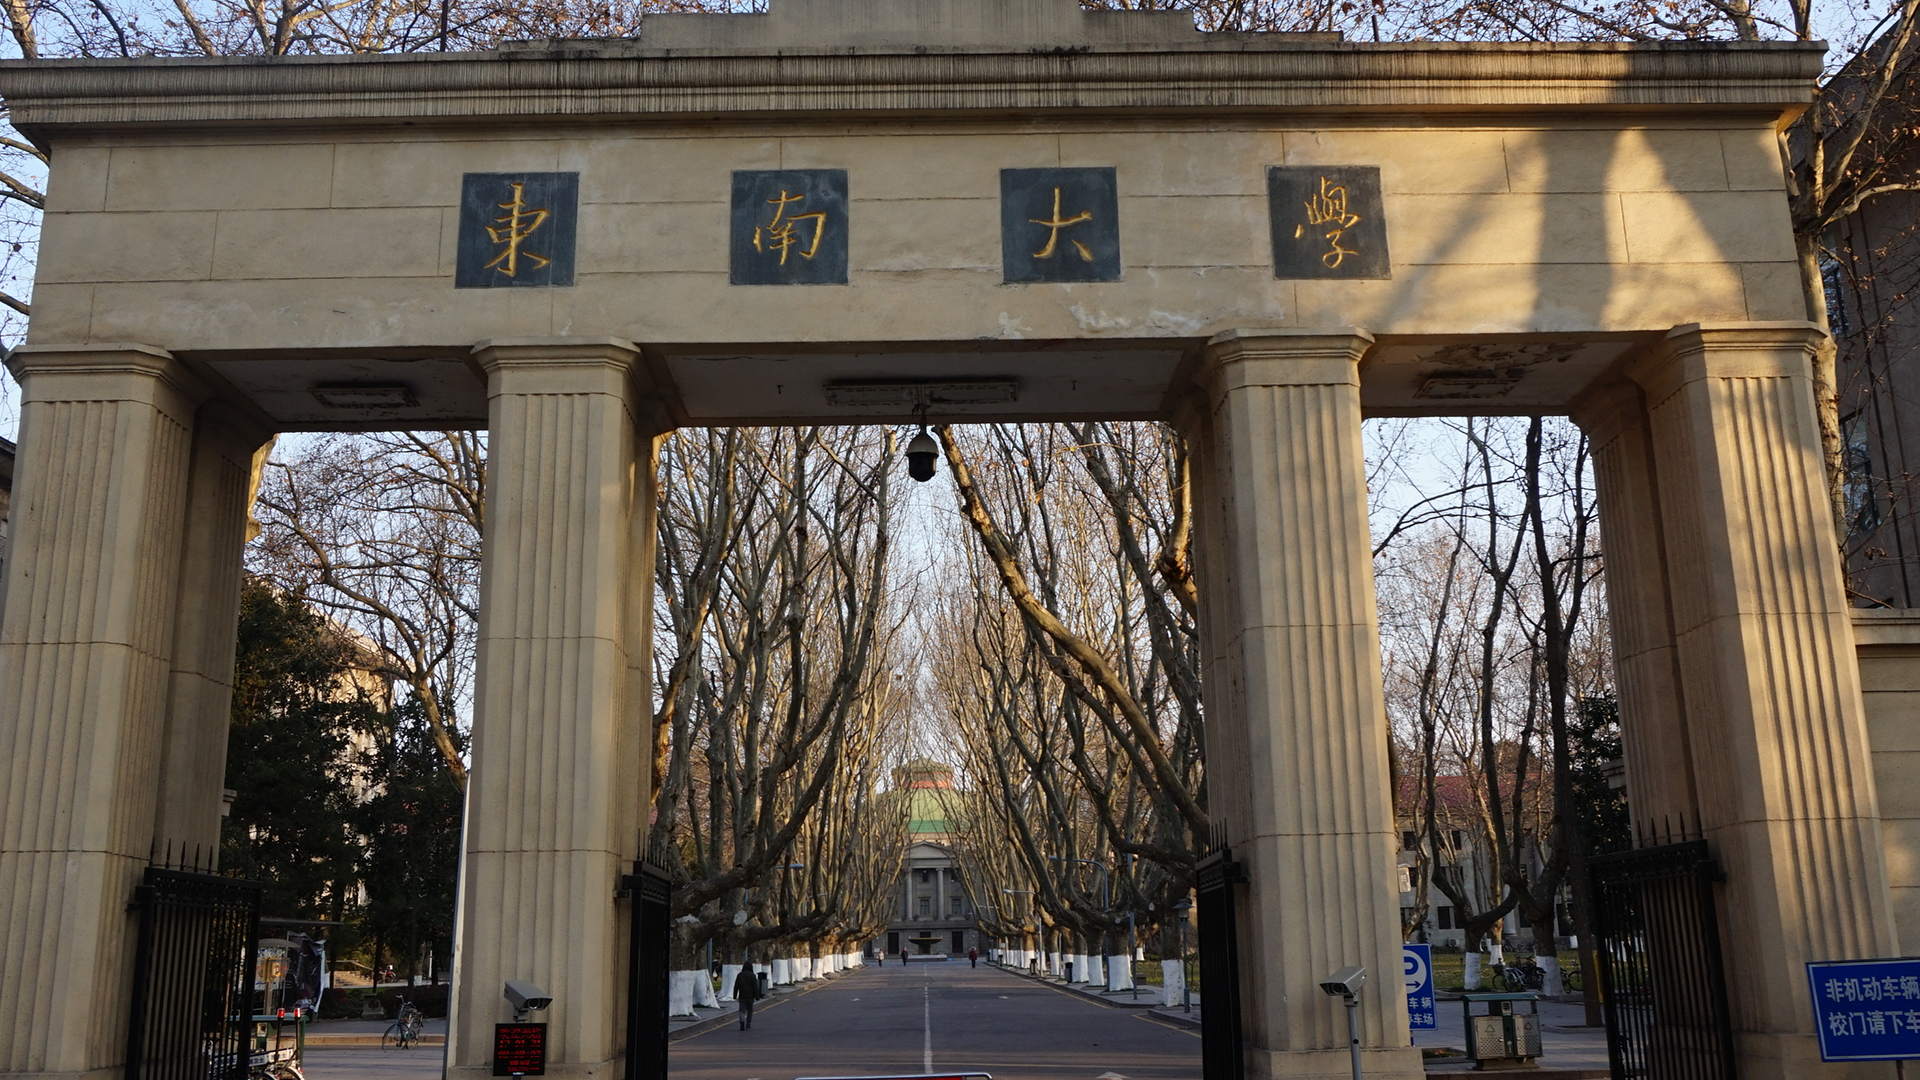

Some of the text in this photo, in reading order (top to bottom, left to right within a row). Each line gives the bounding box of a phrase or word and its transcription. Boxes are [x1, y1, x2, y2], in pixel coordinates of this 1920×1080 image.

[1825, 975, 1920, 1003] 非机动车辆
[1828, 1009, 1920, 1036] 校门请下车
